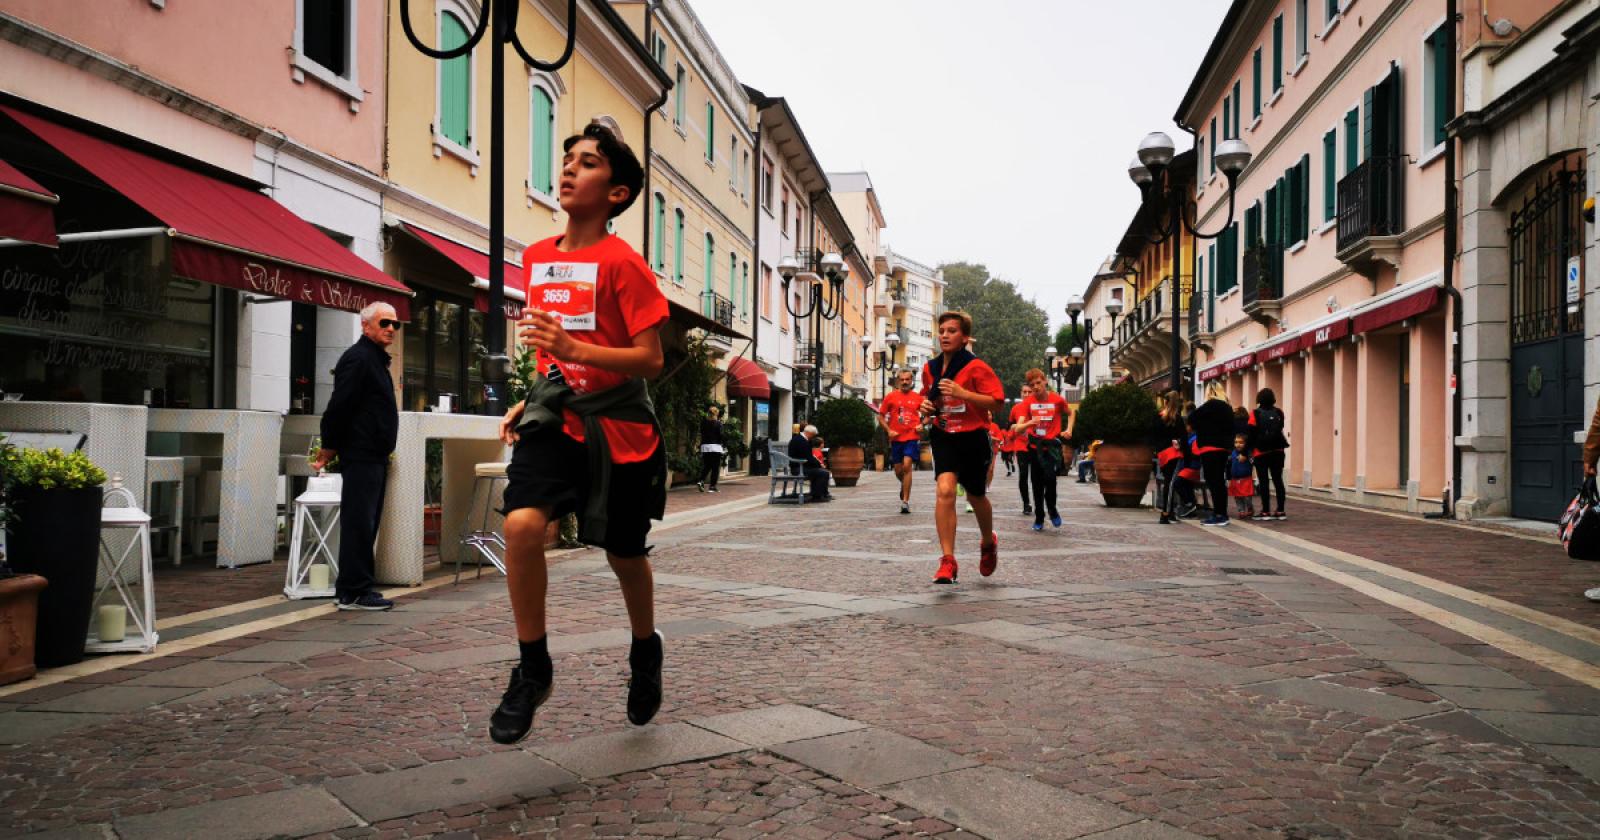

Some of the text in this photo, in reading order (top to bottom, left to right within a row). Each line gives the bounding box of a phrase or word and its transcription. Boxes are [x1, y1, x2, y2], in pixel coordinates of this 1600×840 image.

[243, 262, 292, 296] Dolce
[301, 283, 313, 301] &
[542, 288, 571, 303] 3659
